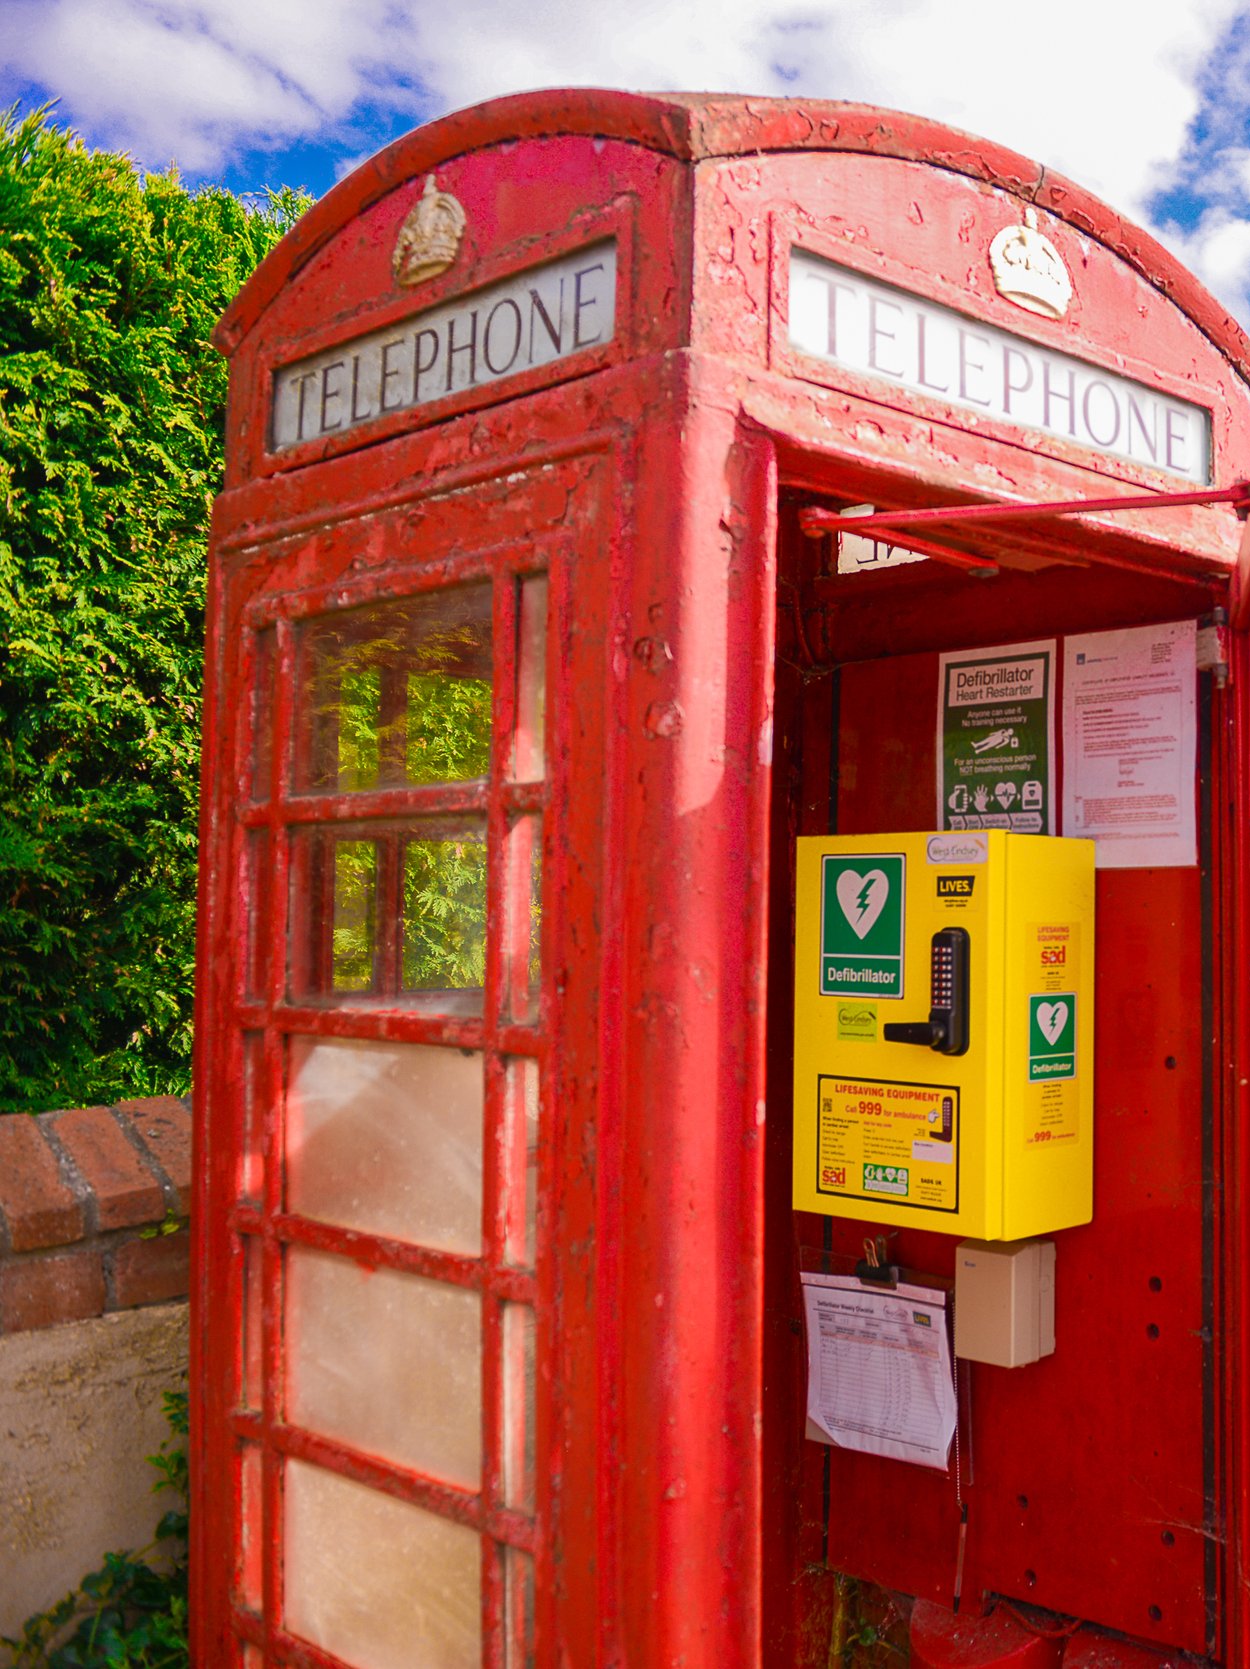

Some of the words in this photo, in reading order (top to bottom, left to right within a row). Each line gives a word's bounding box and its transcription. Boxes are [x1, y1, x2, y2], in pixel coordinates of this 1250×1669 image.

[291, 264, 604, 441] TELEPHONE
[805, 271, 1192, 474] TELEPHONE
[957, 667, 1034, 688] Defibrillator
[956, 689, 983, 701] Heart
[986, 685, 1033, 698] Restarter
[961, 719, 970, 727] No
[972, 718, 994, 727] training
[995, 715, 1028, 725] necessary
[967, 709, 990, 719] Anyone
[991, 708, 1003, 716] can
[1016, 706, 1022, 714] it
[1041, 945, 1066, 964] sad
[828, 967, 896, 983] Defibrillator
[1032, 1063, 1072, 1074] Defibrillator
[835, 1083, 884, 1097] LIFESAVING
[887, 1089, 940, 1102] EQUIPMENT
[845, 1104, 857, 1113] Call
[858, 1101, 882, 1116] 999
[893, 1110, 926, 1121] ambulance
[1034, 1131, 1052, 1142] 999
[822, 1167, 846, 1185] sad
